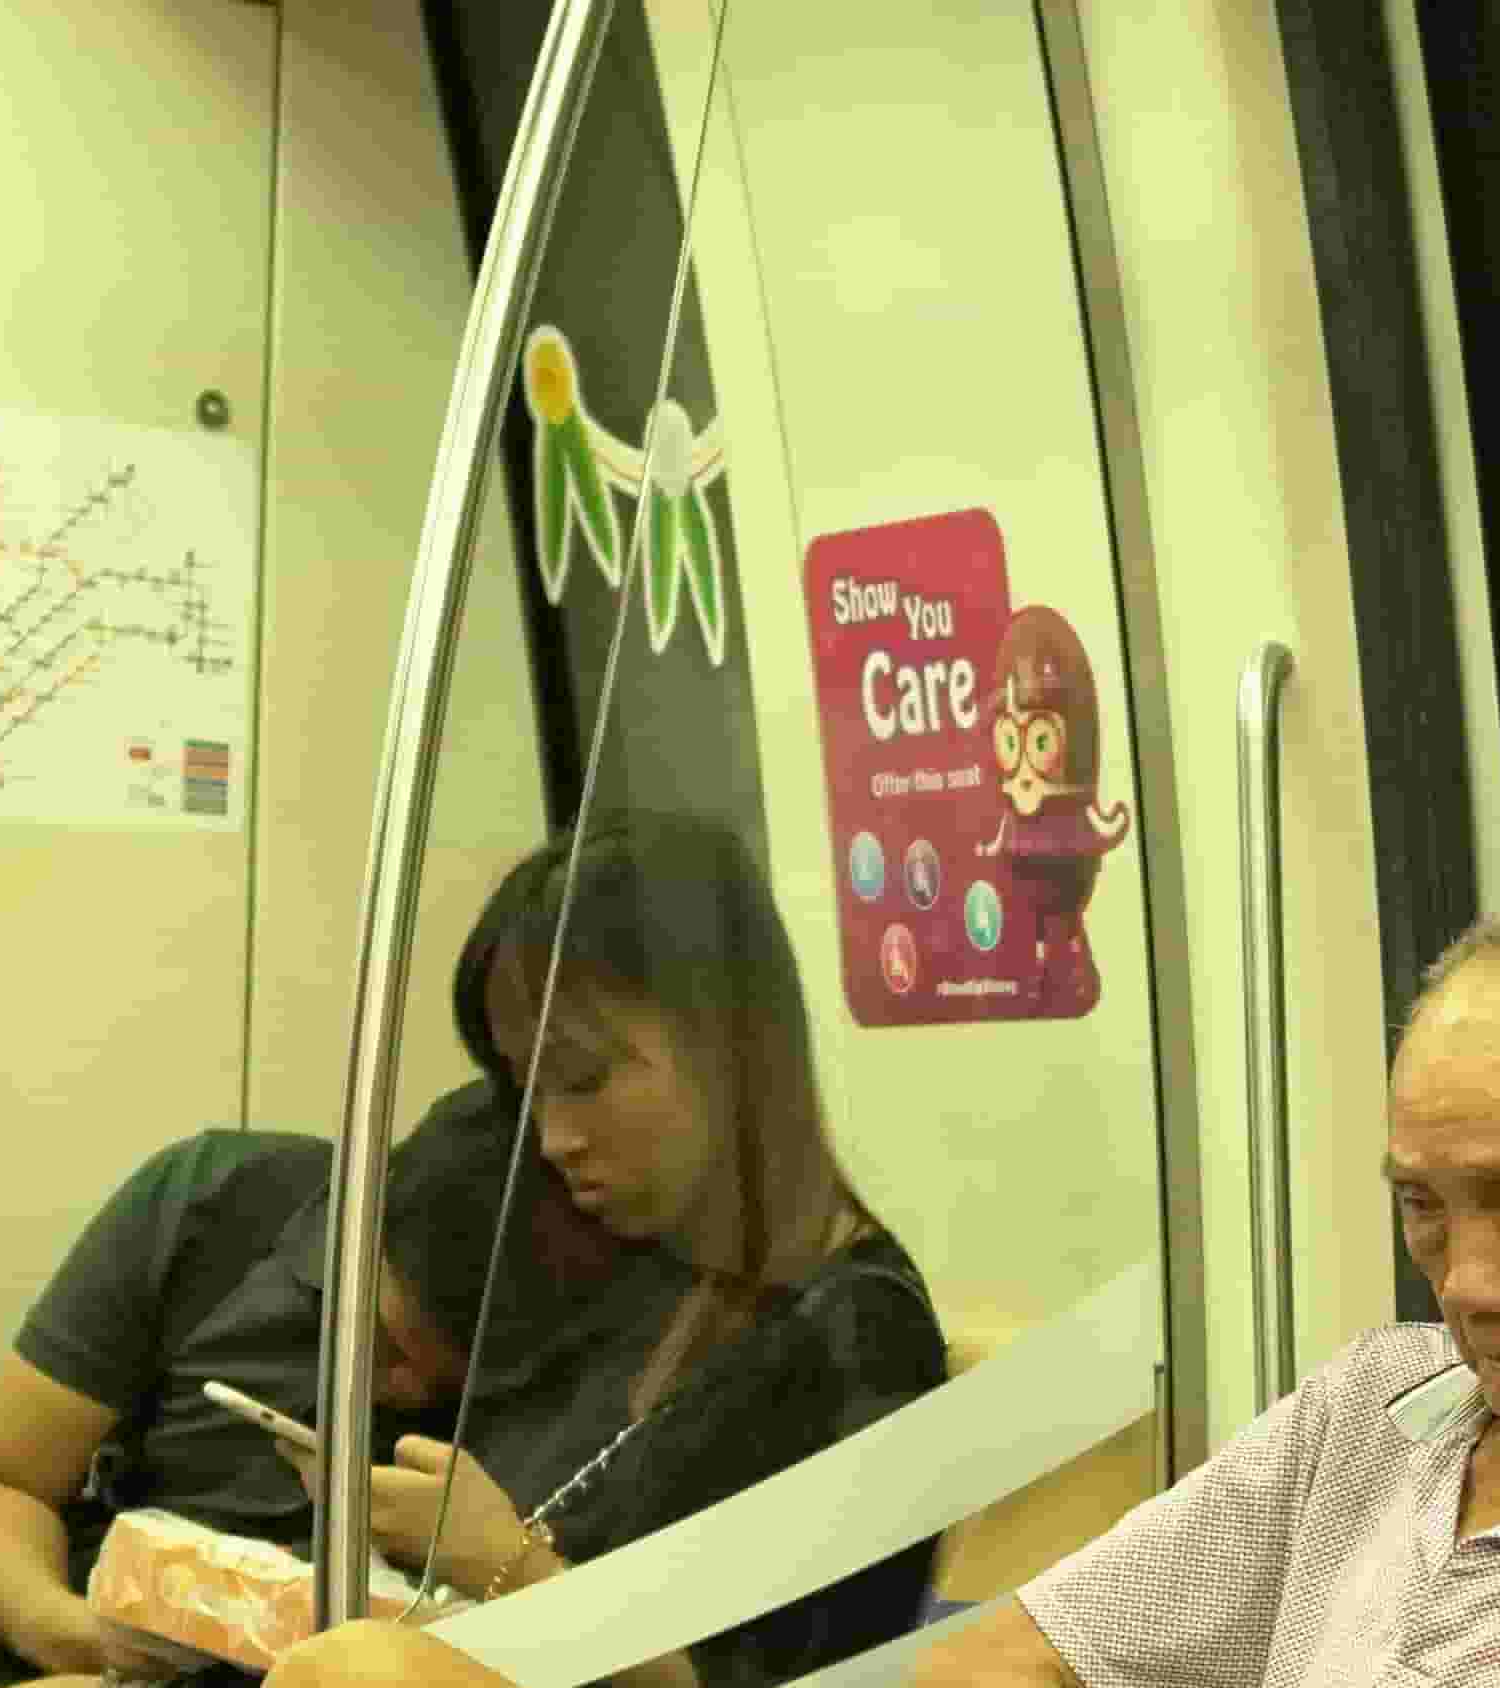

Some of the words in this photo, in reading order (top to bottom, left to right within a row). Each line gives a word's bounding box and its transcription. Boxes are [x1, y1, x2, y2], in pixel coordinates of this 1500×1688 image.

[832, 576, 898, 625] Show
[904, 595, 953, 640] You
[861, 650, 978, 740] Care
[871, 771, 908, 799] Offer
[915, 767, 943, 792] this
[947, 762, 981, 791] seat
